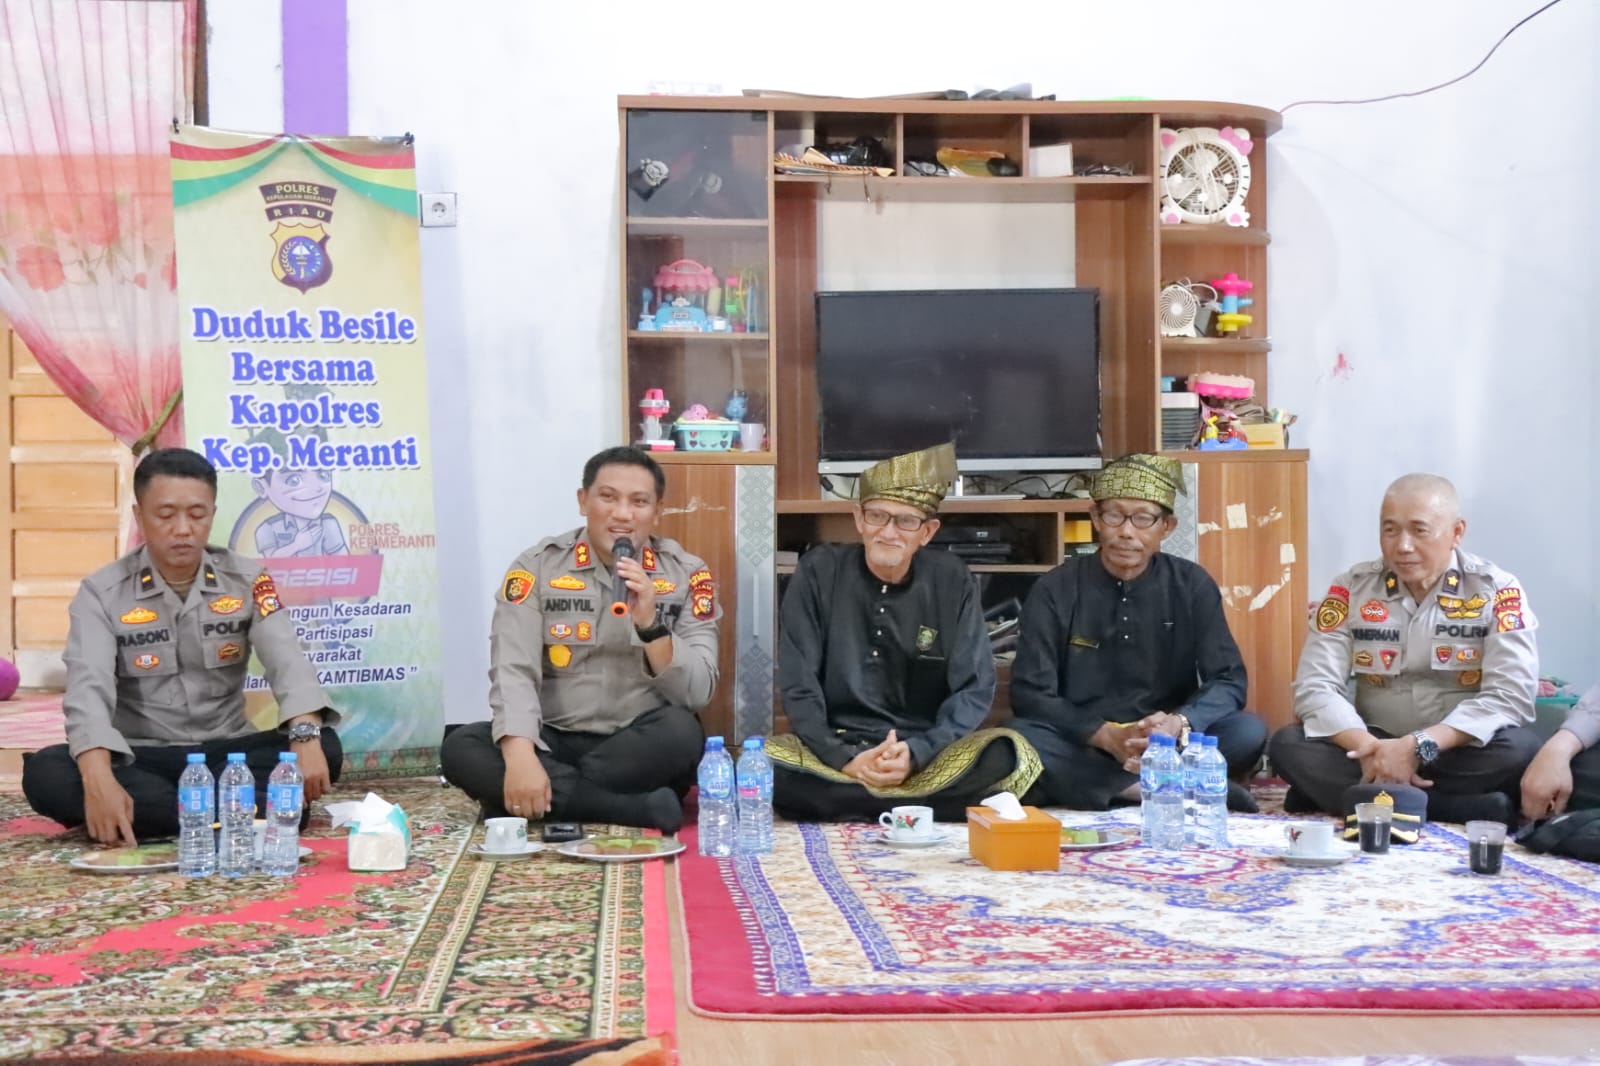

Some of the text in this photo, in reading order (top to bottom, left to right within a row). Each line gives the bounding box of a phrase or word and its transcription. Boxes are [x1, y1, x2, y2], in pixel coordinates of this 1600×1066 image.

[275, 184, 319, 195] POLRES
[273, 207, 326, 219] RIAU
[192, 307, 415, 340] Duduk Besile
[231, 352, 375, 382] Bersama
[230, 395, 380, 431] Kapolres
[202, 437, 418, 474] Kep. Meranti
[349, 523, 400, 537] POLRES
[272, 567, 359, 587] RESISI
[288, 602, 411, 622] ngun Kesadaran
[544, 598, 594, 612] ANDI YUL
[296, 625, 373, 643] Partisipasi
[303, 648, 362, 663] yarakat
[317, 667, 405, 685] KAMTIBMAS
